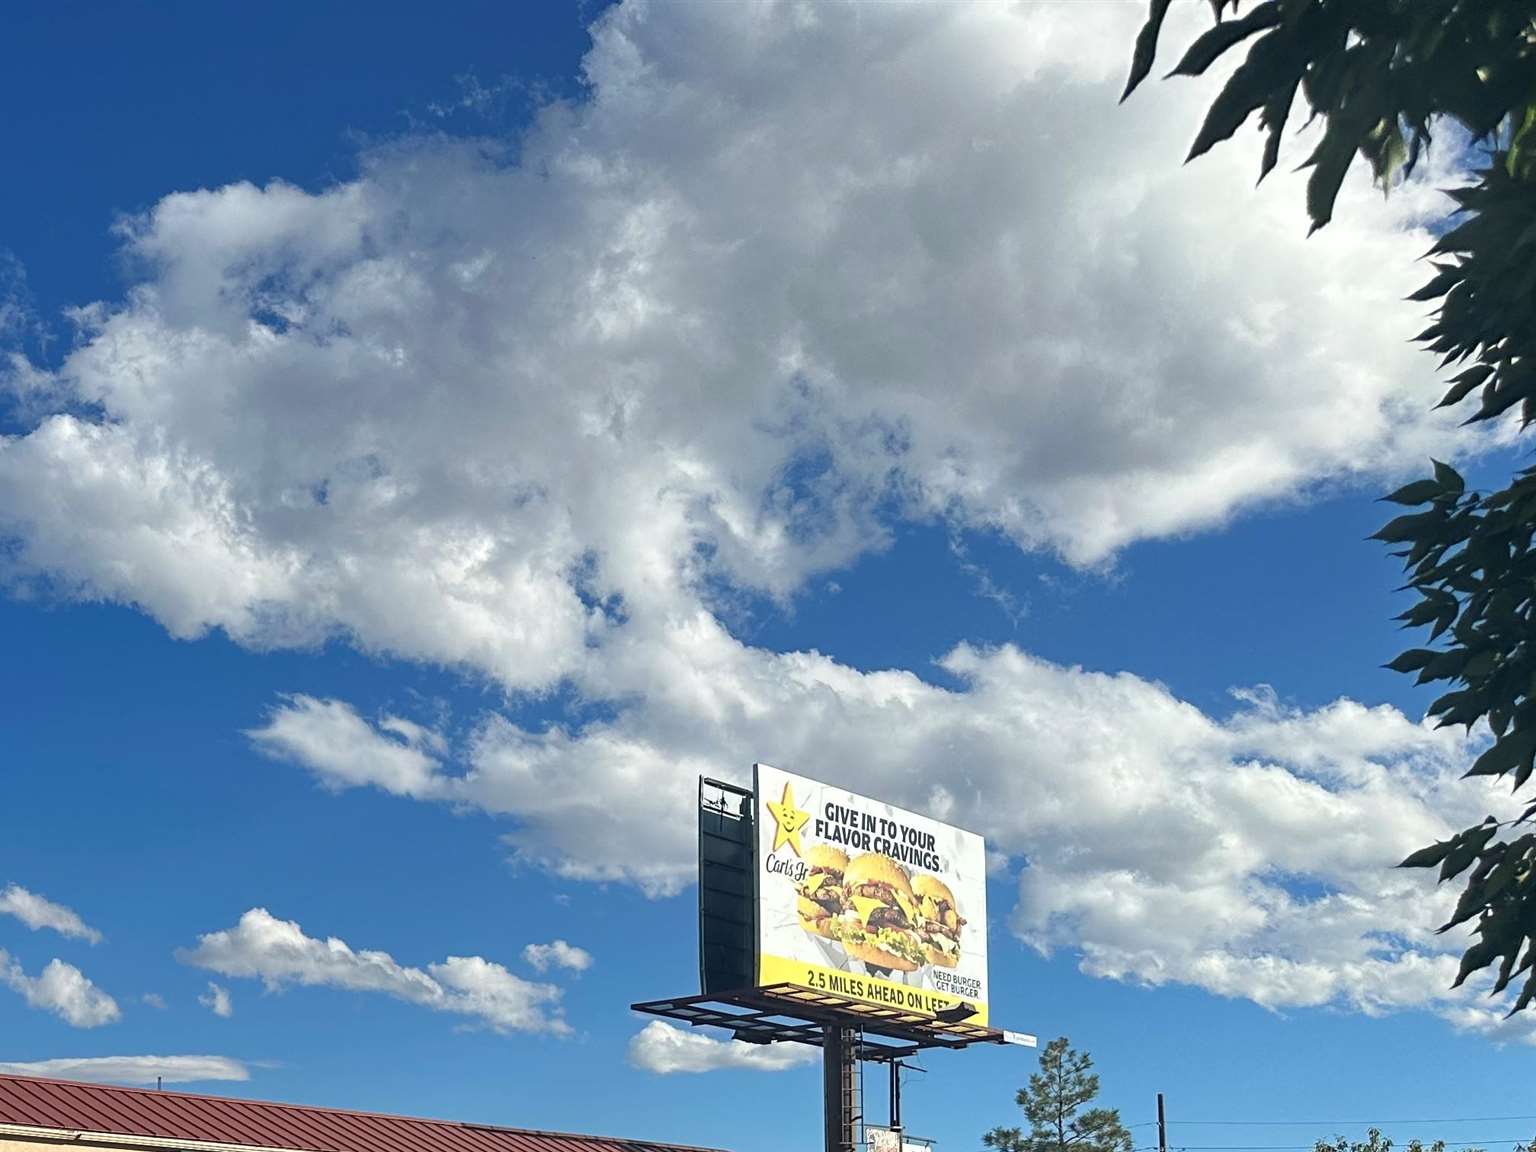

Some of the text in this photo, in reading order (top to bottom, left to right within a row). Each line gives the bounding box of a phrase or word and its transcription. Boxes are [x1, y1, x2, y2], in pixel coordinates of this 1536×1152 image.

[825, 802, 936, 852] GIVE IN TO YOUR
[815, 819, 944, 873] FLAVOR CRAVINGS.
[766, 853, 793, 877] Carl's
[808, 970, 826, 989] 2.5
[829, 975, 864, 997] MILES
[867, 984, 904, 1005] AHEAD
[908, 992, 923, 1009] ON
[933, 969, 952, 983] NEED
[936, 980, 950, 993] GET
